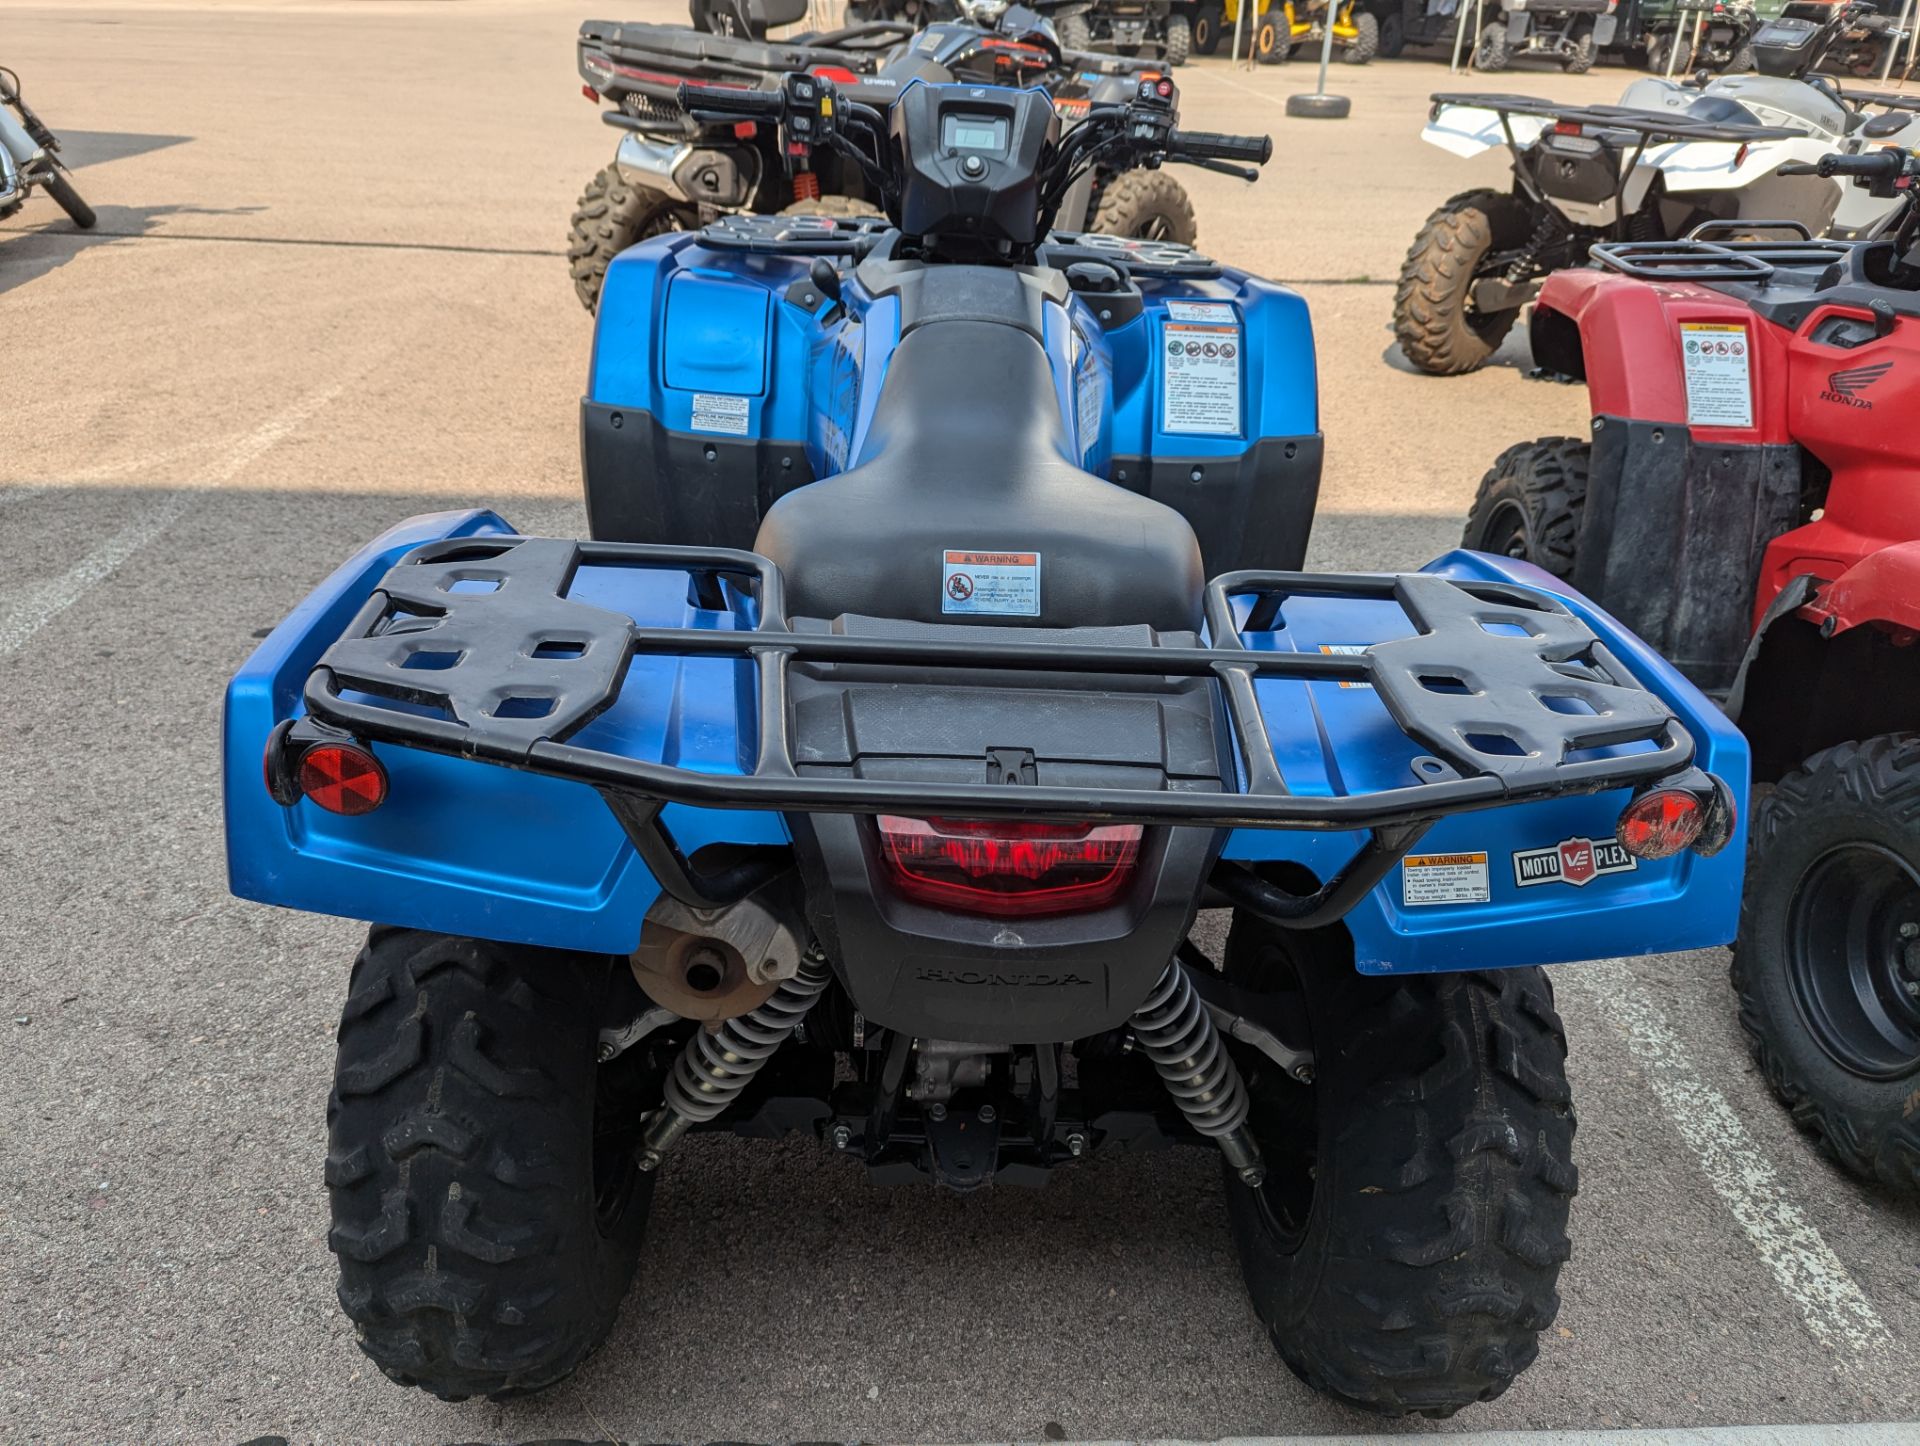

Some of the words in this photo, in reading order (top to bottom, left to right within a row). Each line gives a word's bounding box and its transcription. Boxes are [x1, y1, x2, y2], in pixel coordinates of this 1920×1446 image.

[1819, 390, 1873, 410] HONDA
[975, 555, 1019, 564] WARNING
[1428, 855, 1473, 865] WARNING
[1521, 855, 1558, 877] MOTO
[1595, 845, 1629, 866] PLEX
[915, 967, 1093, 986] HONDA
